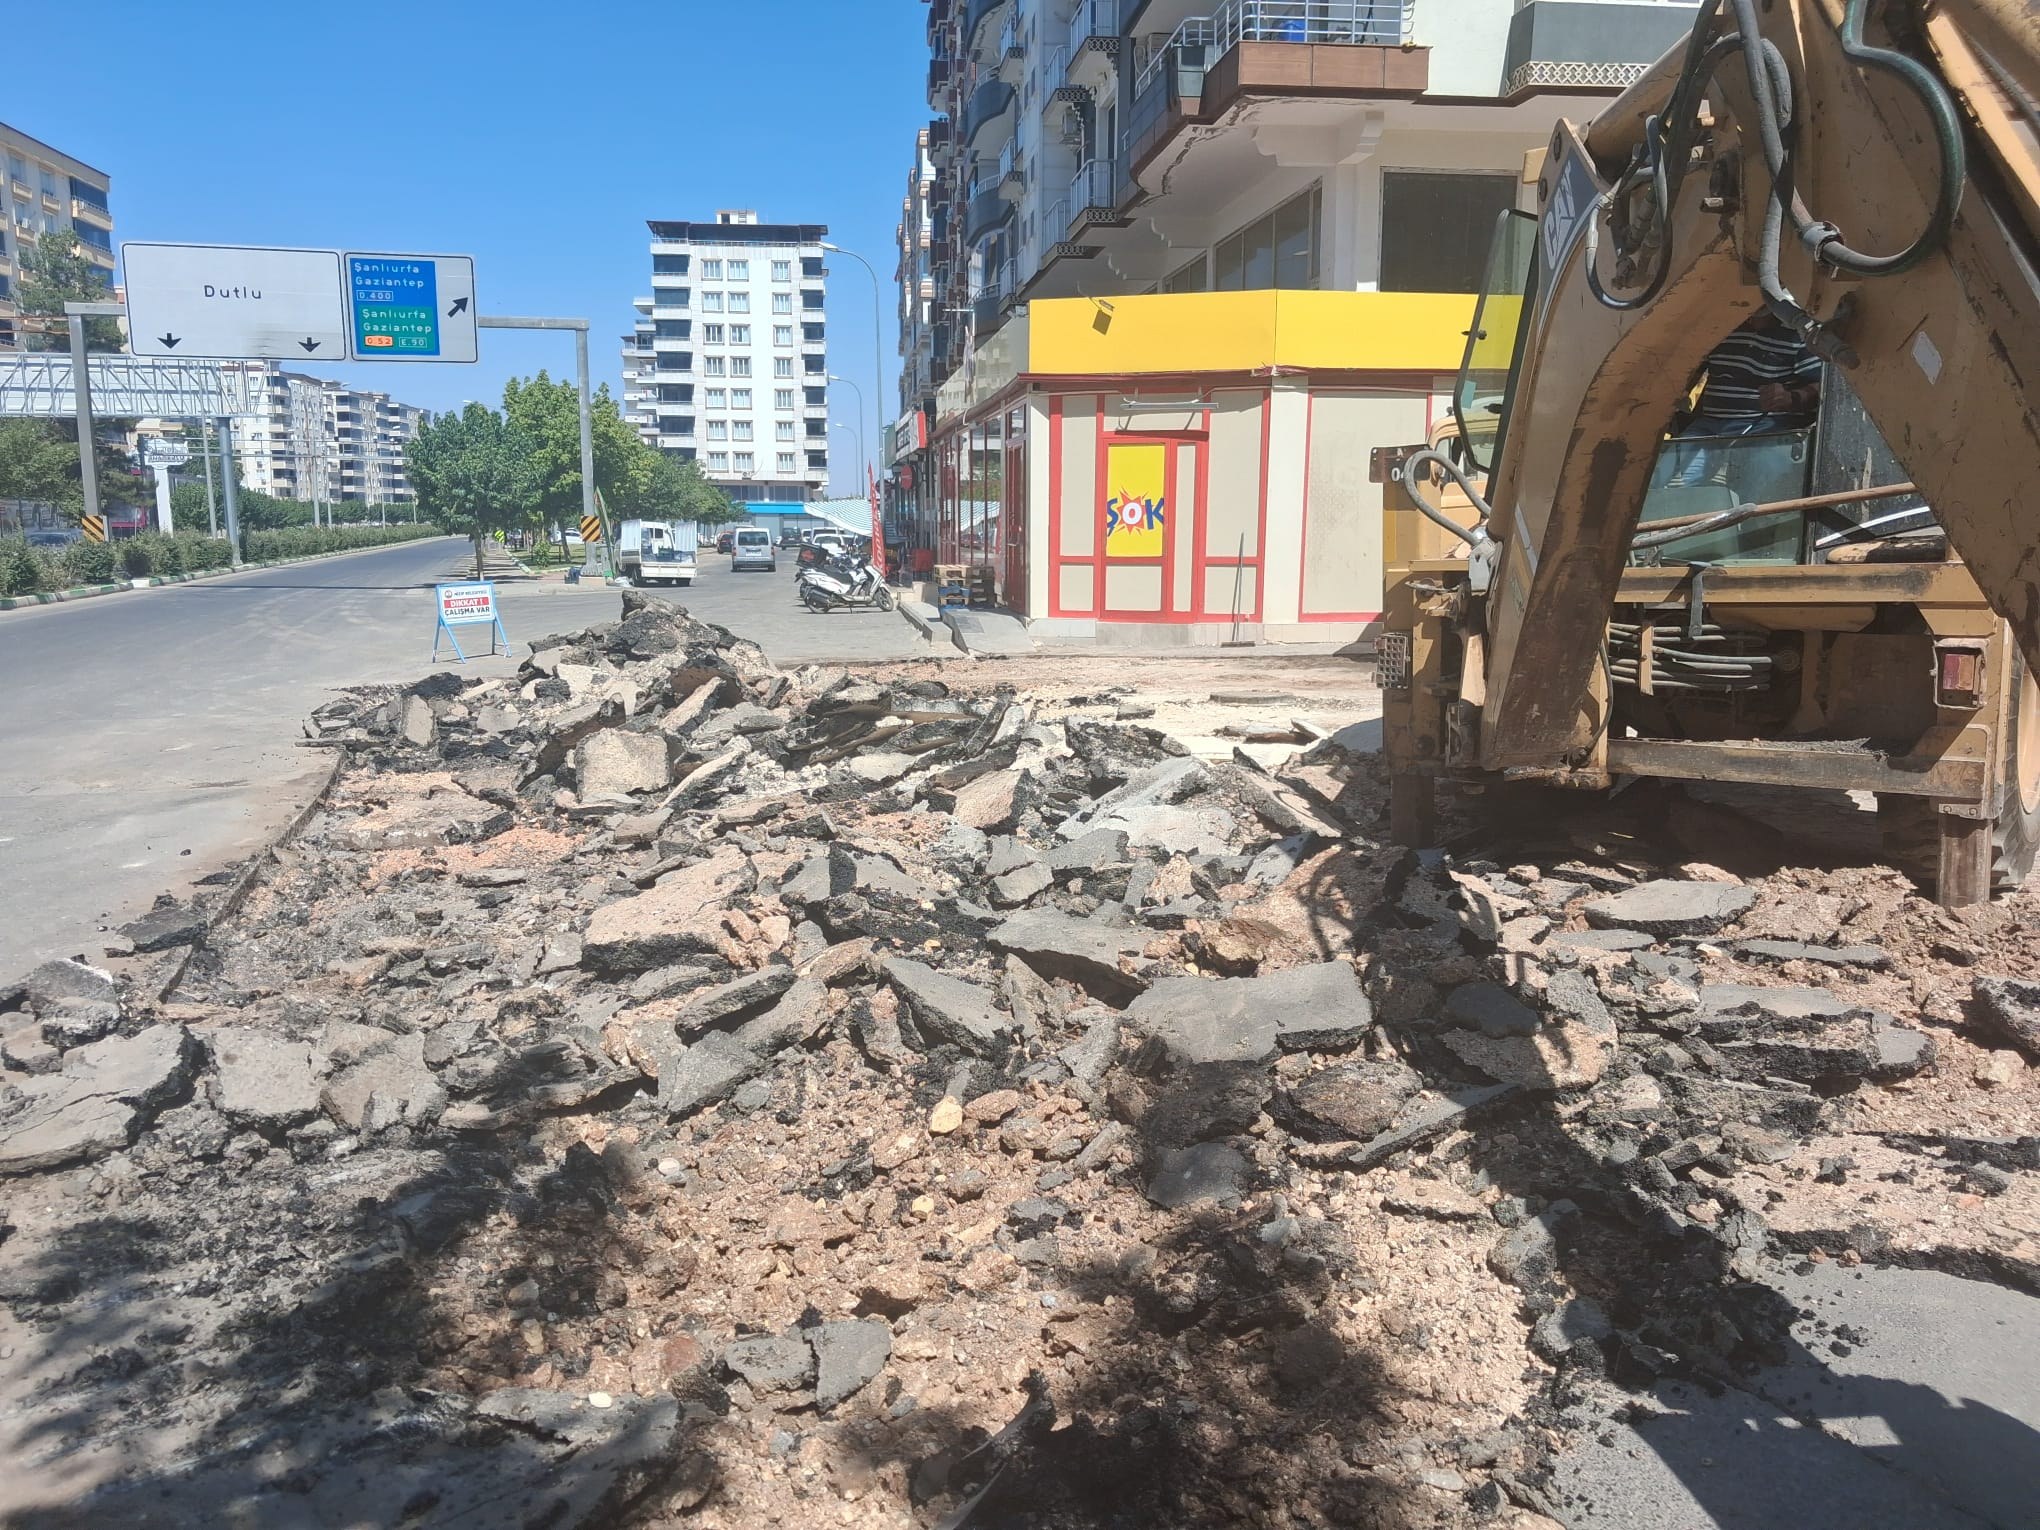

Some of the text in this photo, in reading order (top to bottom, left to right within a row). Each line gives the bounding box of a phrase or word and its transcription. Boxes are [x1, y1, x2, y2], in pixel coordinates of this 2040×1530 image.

[354, 262, 420, 274] Şanlıurfa
[355, 276, 424, 288] Gaziantep
[203, 284, 262, 300] Dutlu
[359, 292, 391, 300] D.400
[362, 308, 426, 320] Şanlıurfa
[363, 322, 432, 334] Gaziantep
[1106, 497, 1165, 537] ŞOK
